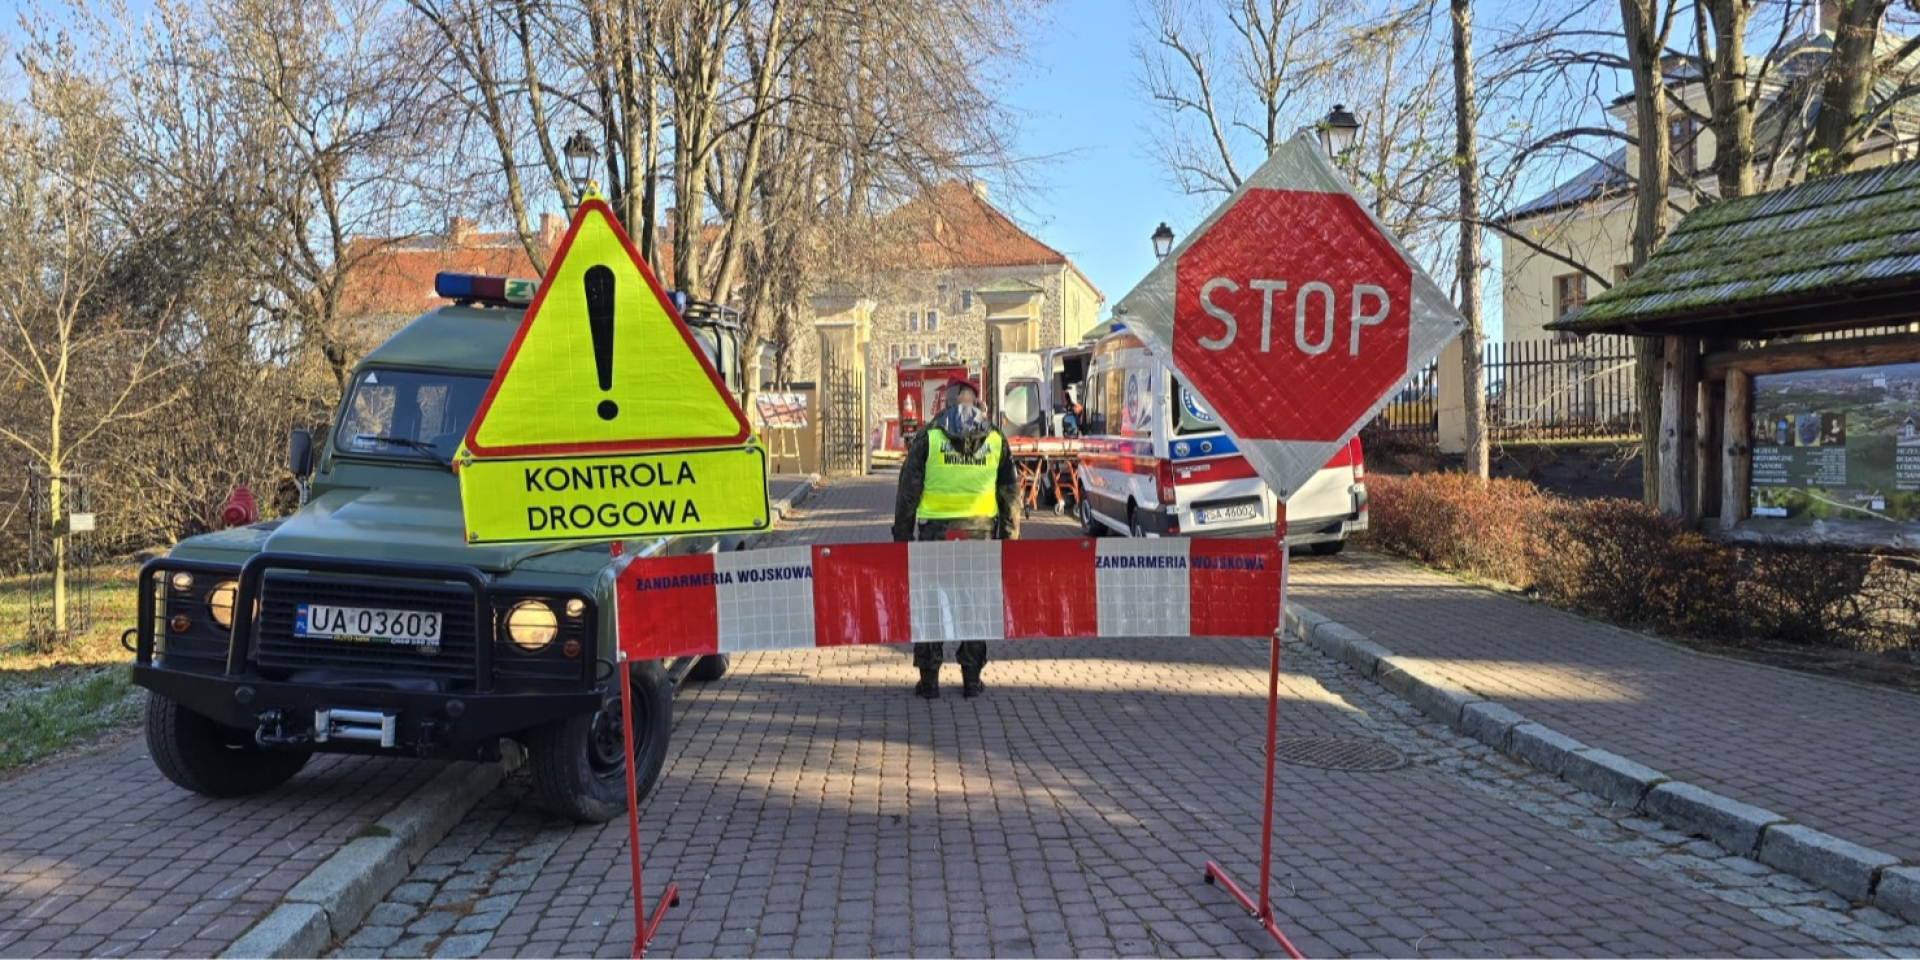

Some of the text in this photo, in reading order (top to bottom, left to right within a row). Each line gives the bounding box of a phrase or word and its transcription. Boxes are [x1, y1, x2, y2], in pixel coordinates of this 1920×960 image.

[1198, 277, 1390, 356] STOP
[525, 461, 696, 491] KONTROLA
[527, 499, 700, 530] DROGOWA
[1225, 504, 1254, 518] 46002
[737, 566, 813, 583] WOJSKOWA
[1191, 556, 1265, 570] WOJSKOWA
[312, 608, 438, 638] UA 03603
